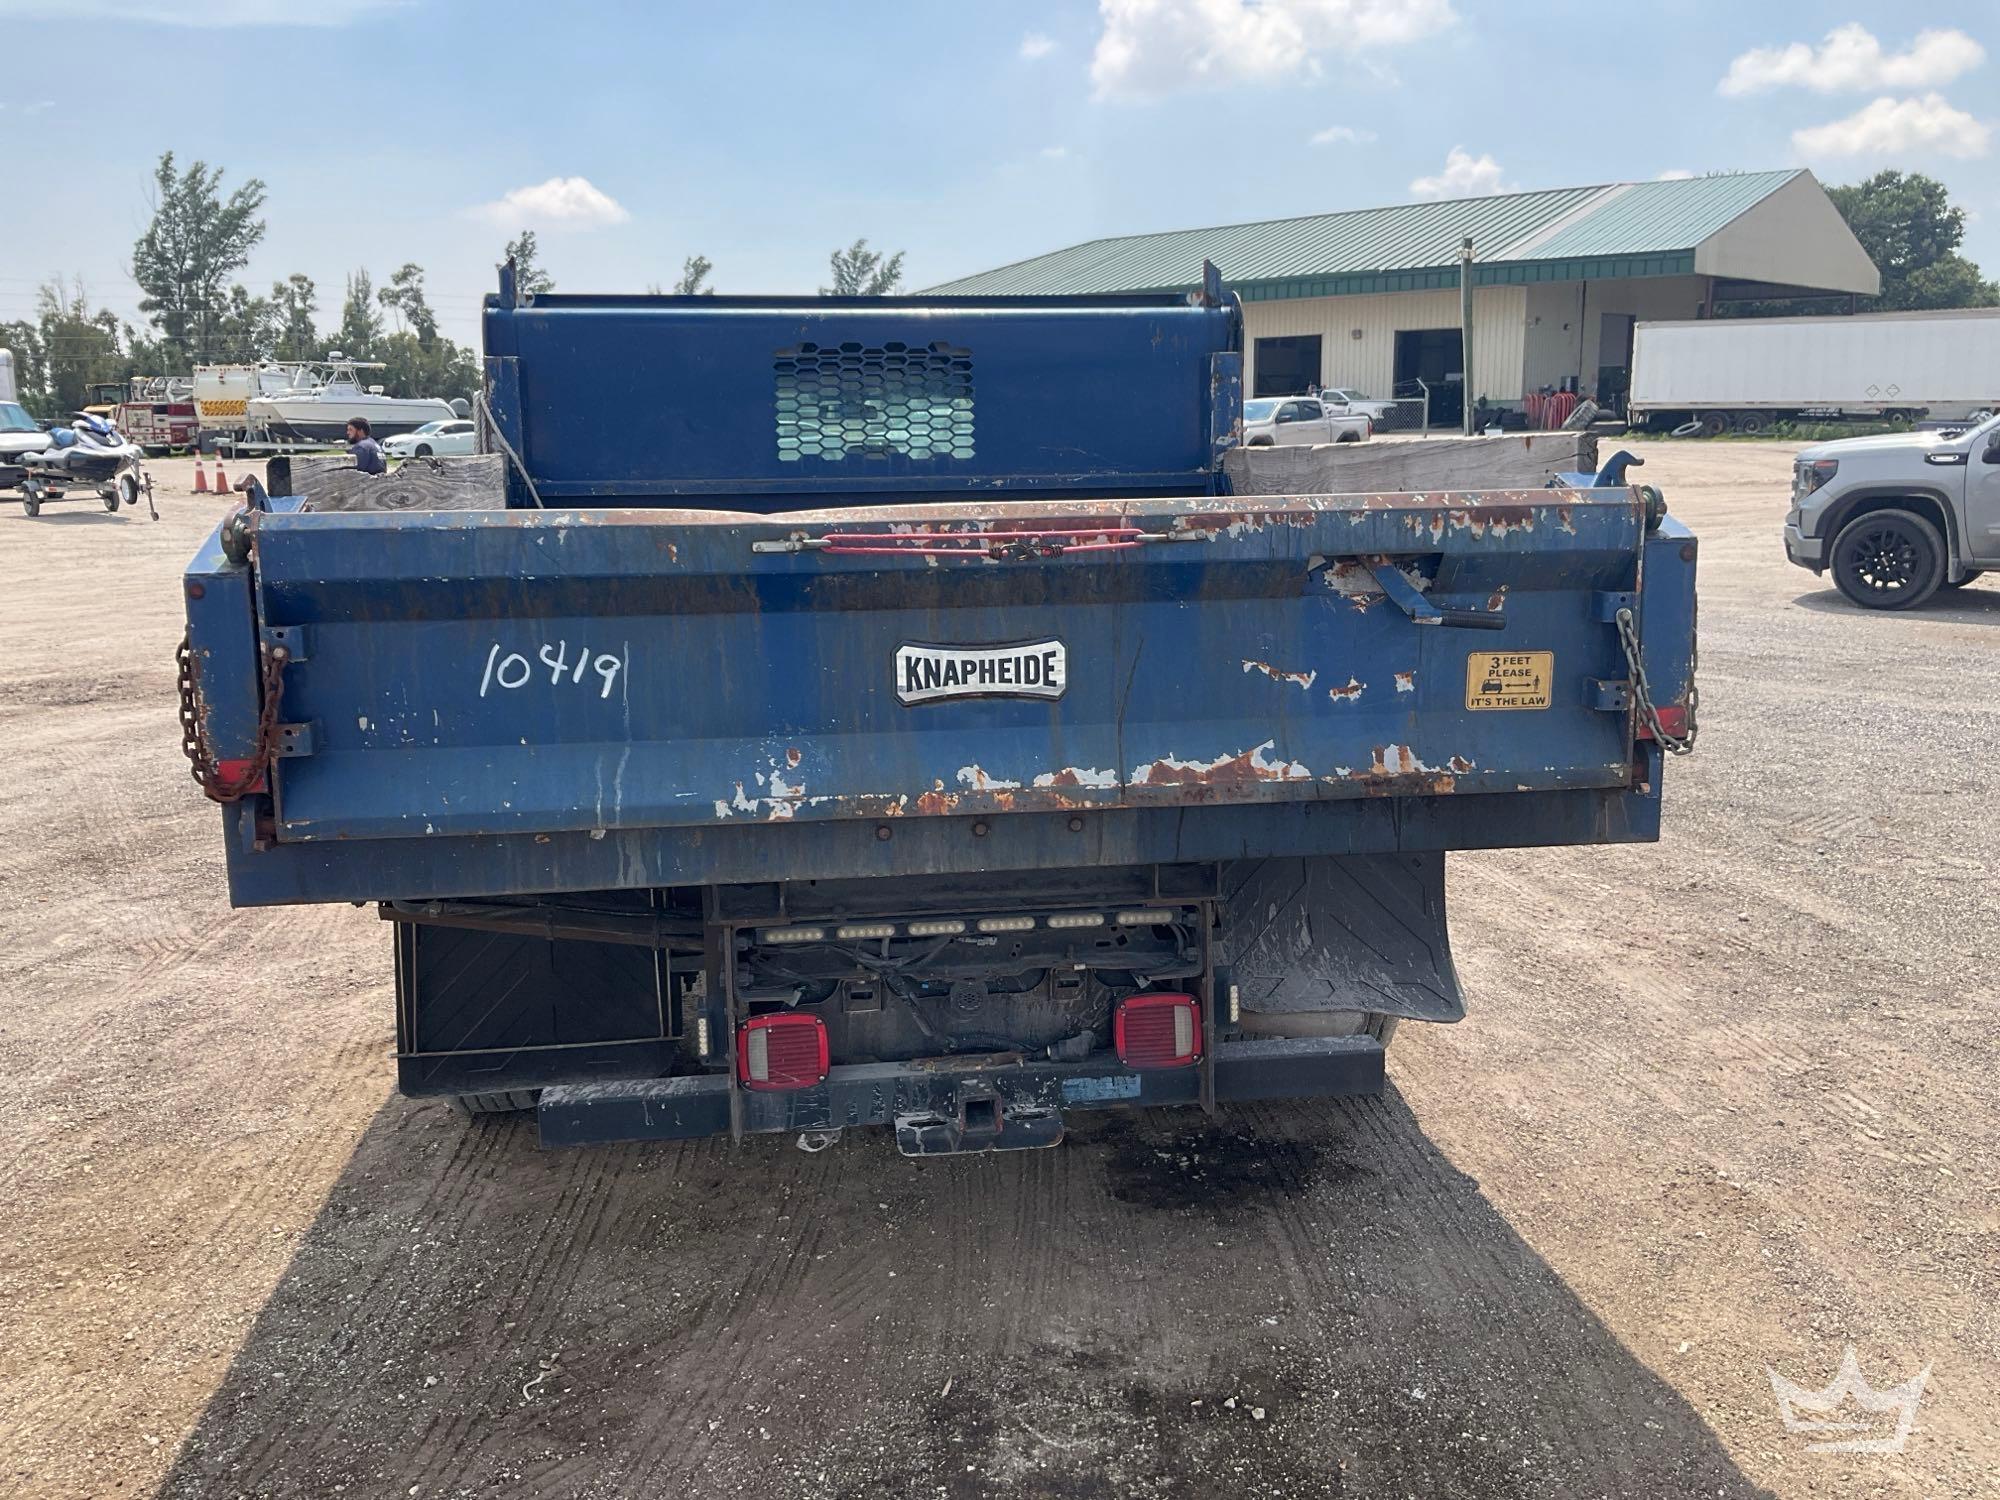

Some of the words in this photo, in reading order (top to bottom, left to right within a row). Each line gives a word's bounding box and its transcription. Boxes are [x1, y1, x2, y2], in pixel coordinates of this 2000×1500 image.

[480, 640, 621, 698] 10419
[1491, 656, 1501, 669] 3
[1503, 656, 1531, 665] FEET
[905, 650, 1057, 692] KNAPHEIDE
[1488, 668, 1532, 677] PLEASE
[1471, 697, 1492, 706] IT'S
[1497, 697, 1518, 706] THE
[1521, 697, 1546, 705] LAW
